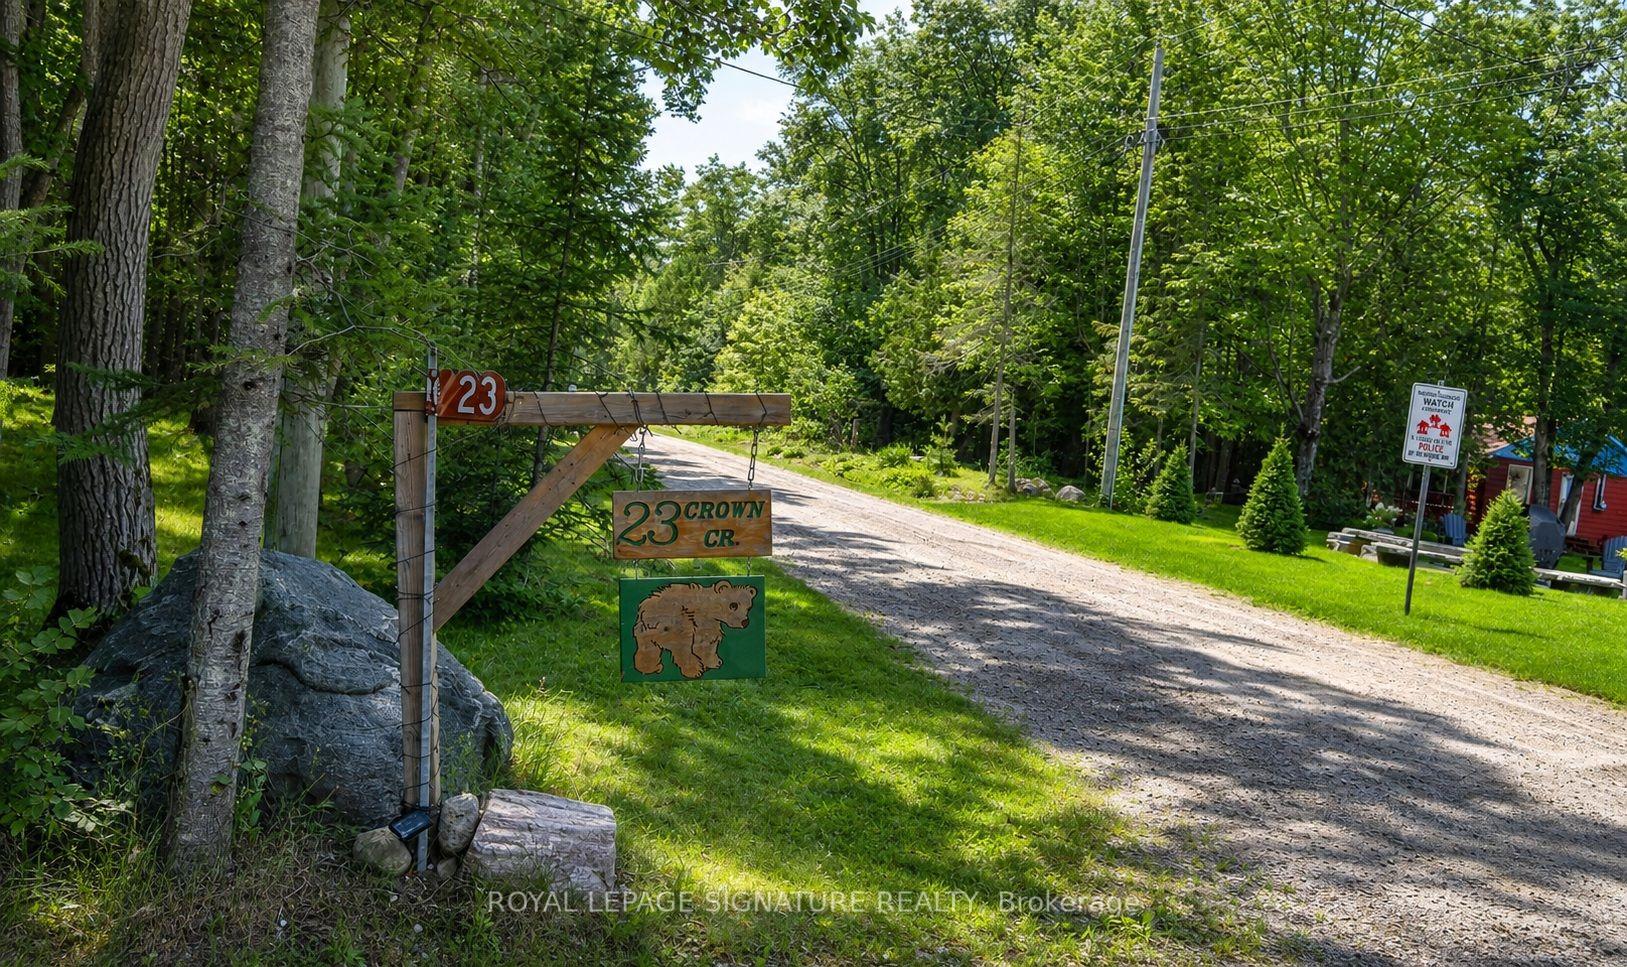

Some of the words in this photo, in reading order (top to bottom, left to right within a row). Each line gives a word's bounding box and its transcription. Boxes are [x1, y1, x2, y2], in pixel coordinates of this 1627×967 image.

[457, 374, 497, 415] 23
[1423, 397, 1454, 409] WATCH
[1418, 442, 1444, 454] POLICE
[616, 500, 682, 547] 23
[682, 500, 766, 521] CROWN
[703, 528, 741, 549] CR.
